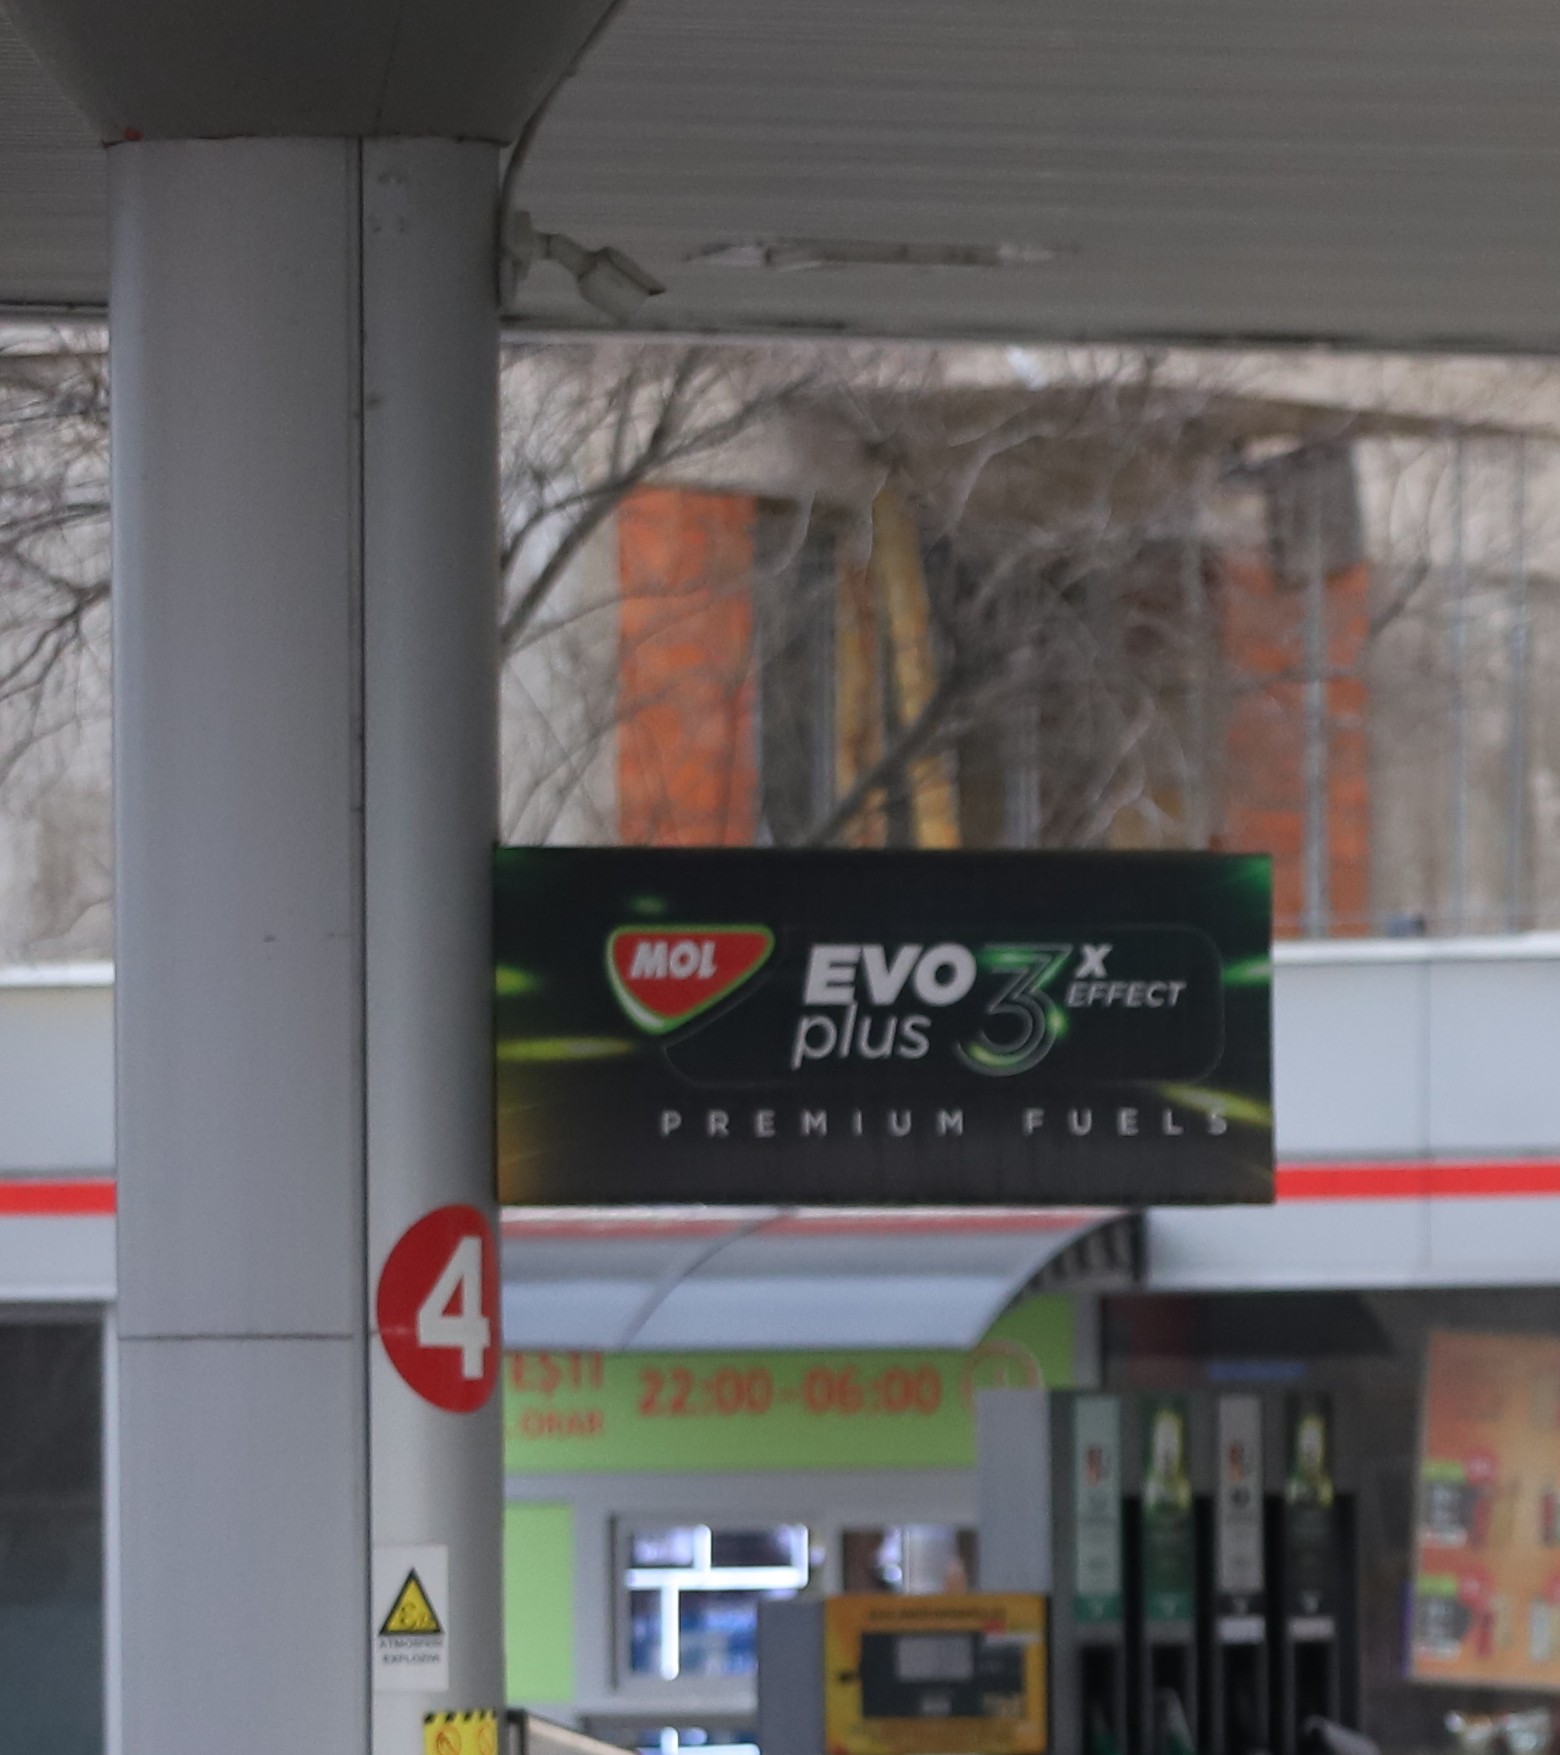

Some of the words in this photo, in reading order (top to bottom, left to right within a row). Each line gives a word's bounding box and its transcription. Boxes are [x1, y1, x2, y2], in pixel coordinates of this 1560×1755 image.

[629, 940, 718, 980] MOL
[803, 943, 977, 1006] EVO
[1066, 982, 1187, 1008] EFFECT
[791, 1005, 931, 1069] plus
[661, 1109, 967, 1138] PREMIUM
[1023, 1108, 1230, 1135] FUELS
[416, 1237, 492, 1380] 4
